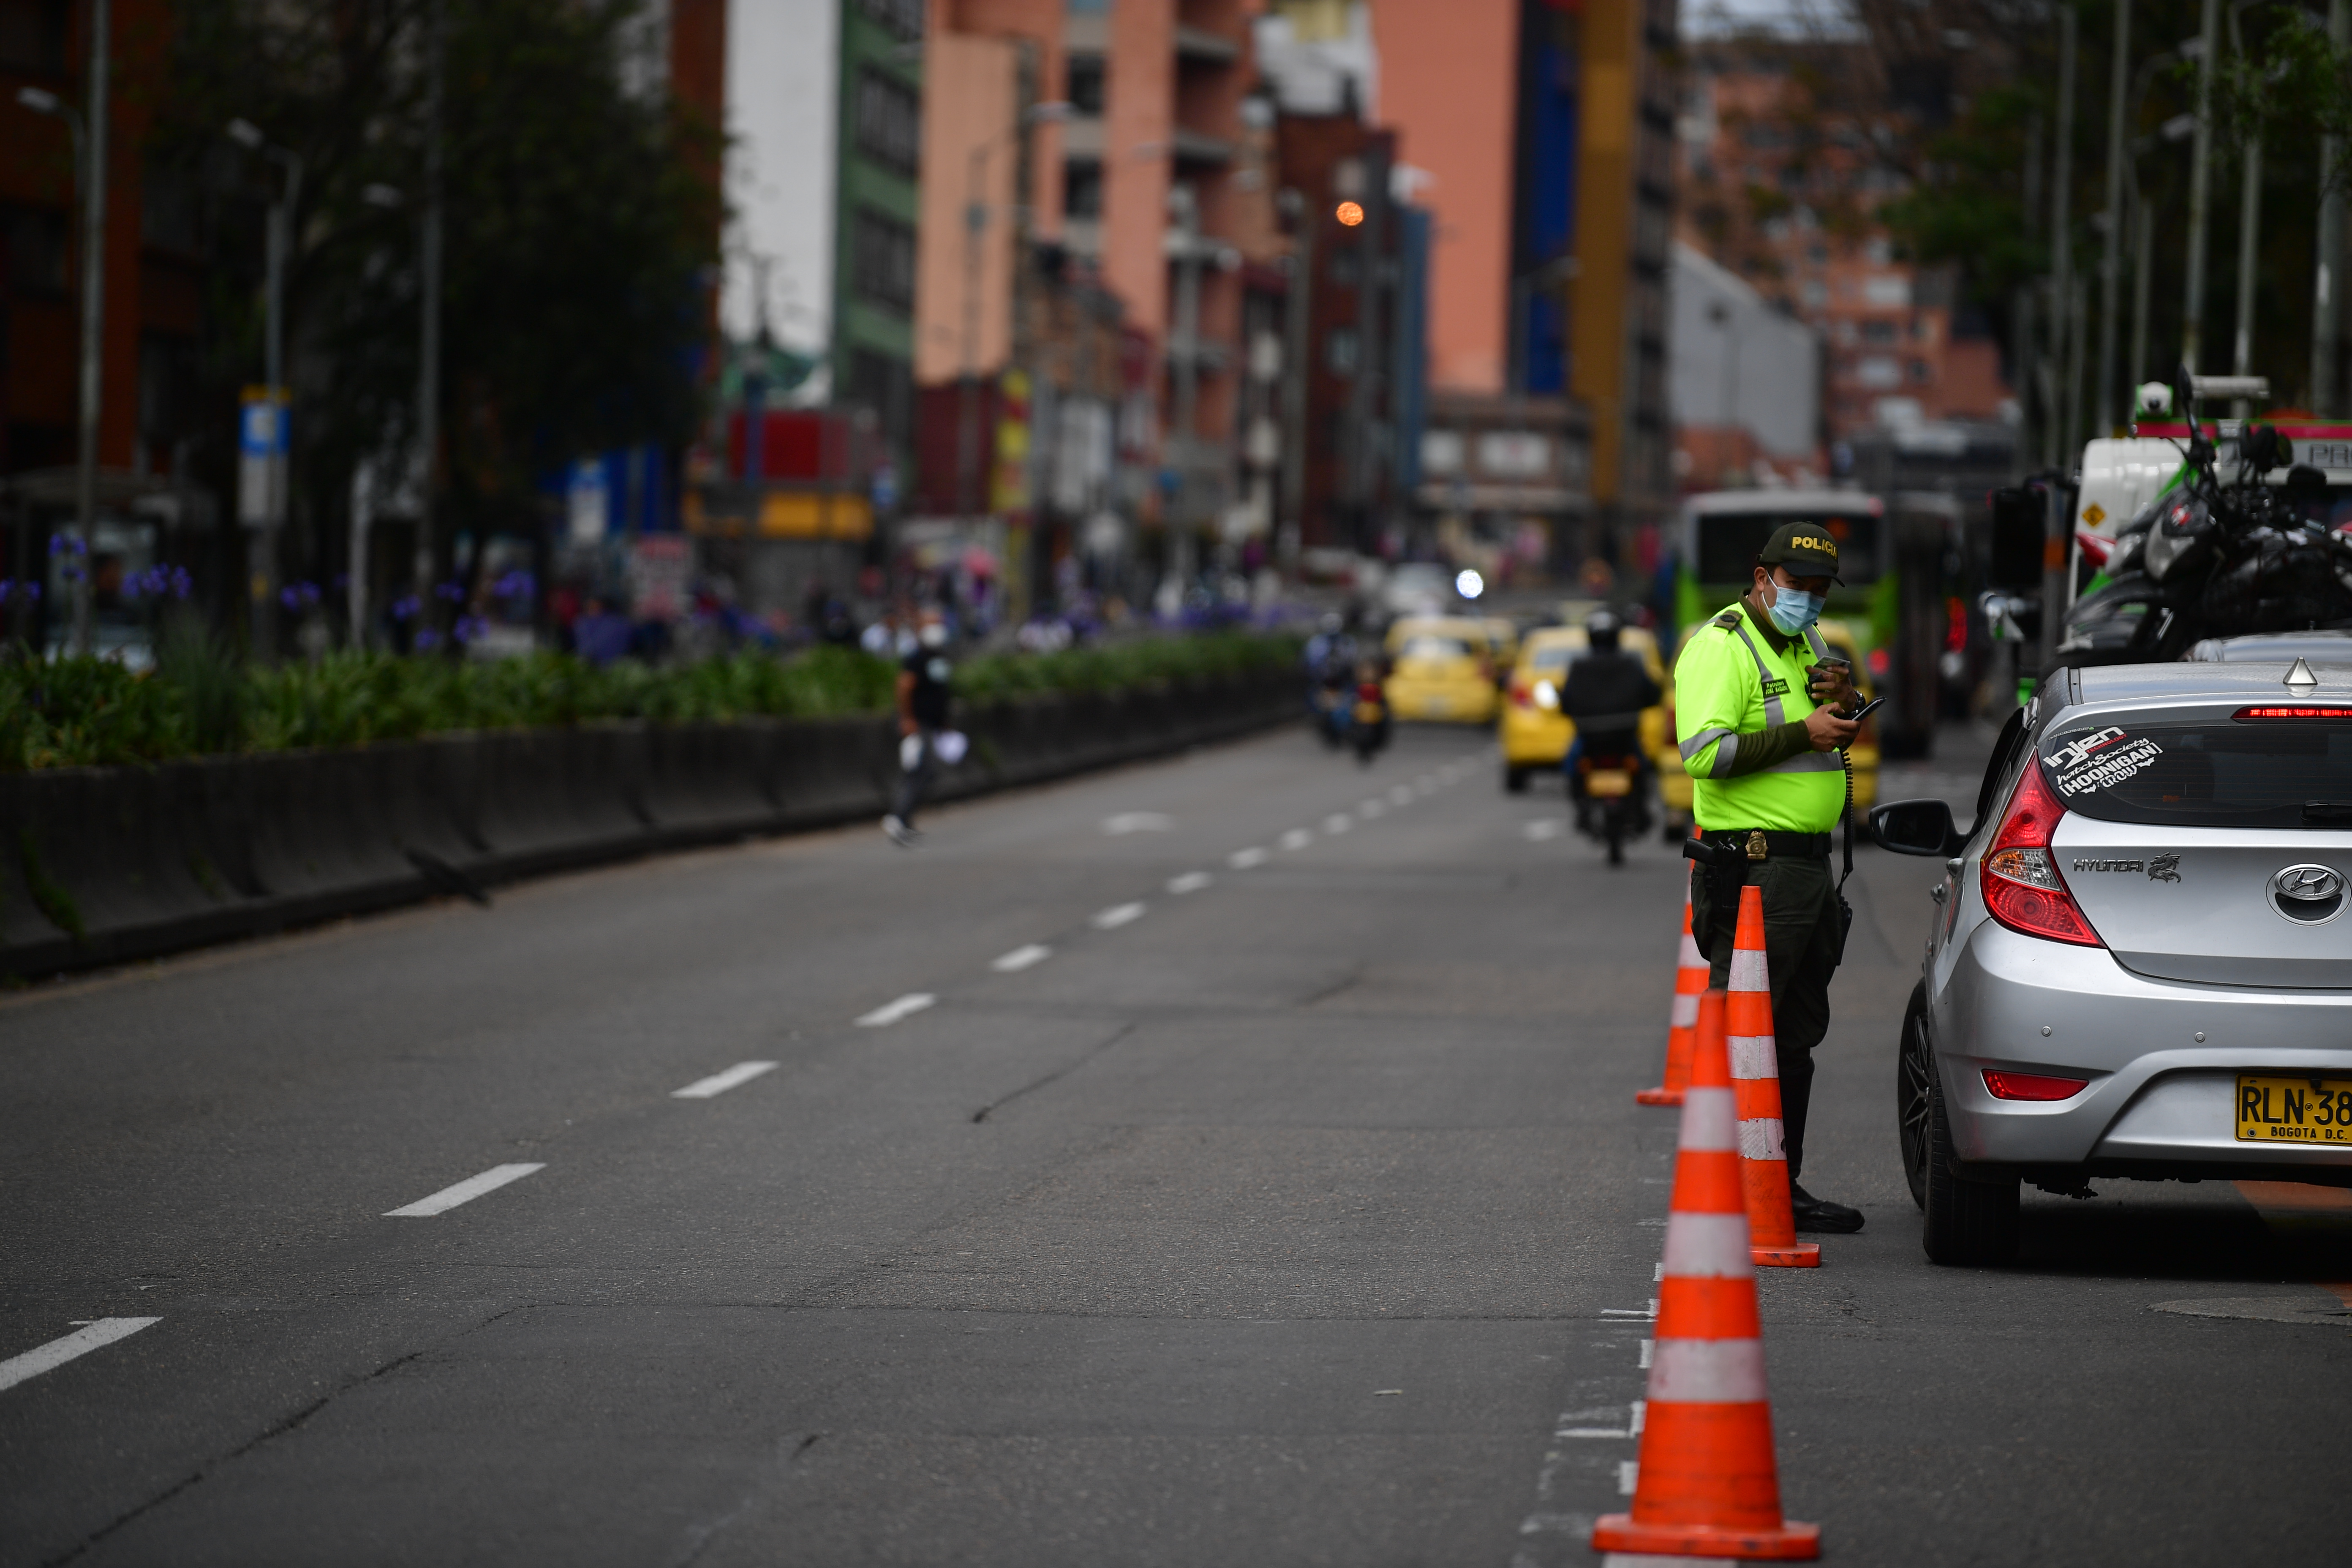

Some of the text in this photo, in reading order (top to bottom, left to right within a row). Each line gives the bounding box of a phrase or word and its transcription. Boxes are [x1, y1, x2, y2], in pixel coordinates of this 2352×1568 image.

[2309, 444, 2352, 464] PA
[1792, 536, 1838, 560] POLICIA
[2087, 733, 2127, 754] TECHNOLOGY
[2074, 859, 2144, 872] HYUNDAI
[2241, 1086, 2304, 1124] RLN
[2271, 1126, 2348, 1140] BOGOTA D.C.
